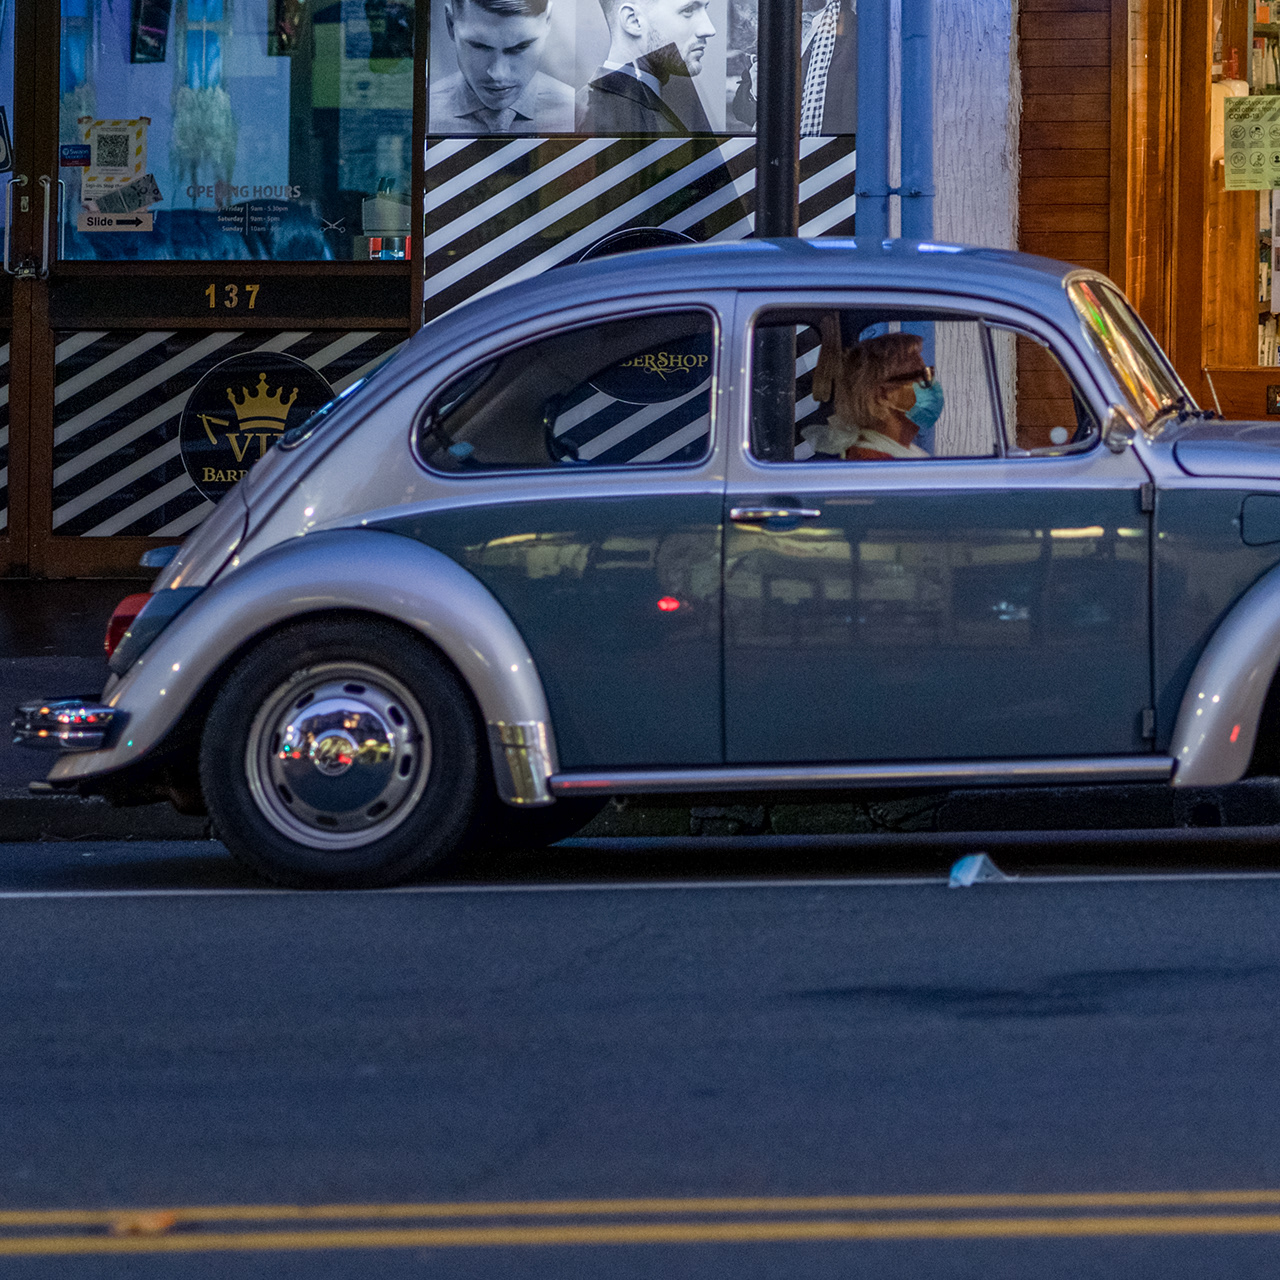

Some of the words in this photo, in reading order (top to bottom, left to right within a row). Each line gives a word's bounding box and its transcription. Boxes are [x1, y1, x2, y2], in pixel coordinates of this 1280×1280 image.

[253, 185, 301, 199] HOURS
[86, 216, 114, 227] Slide
[217, 215, 244, 224] Saturday
[267, 216, 280, 224] 5pm
[221, 225, 244, 233] Sunday
[204, 283, 261, 309] 137
[620, 351, 709, 371] BERSHOP
